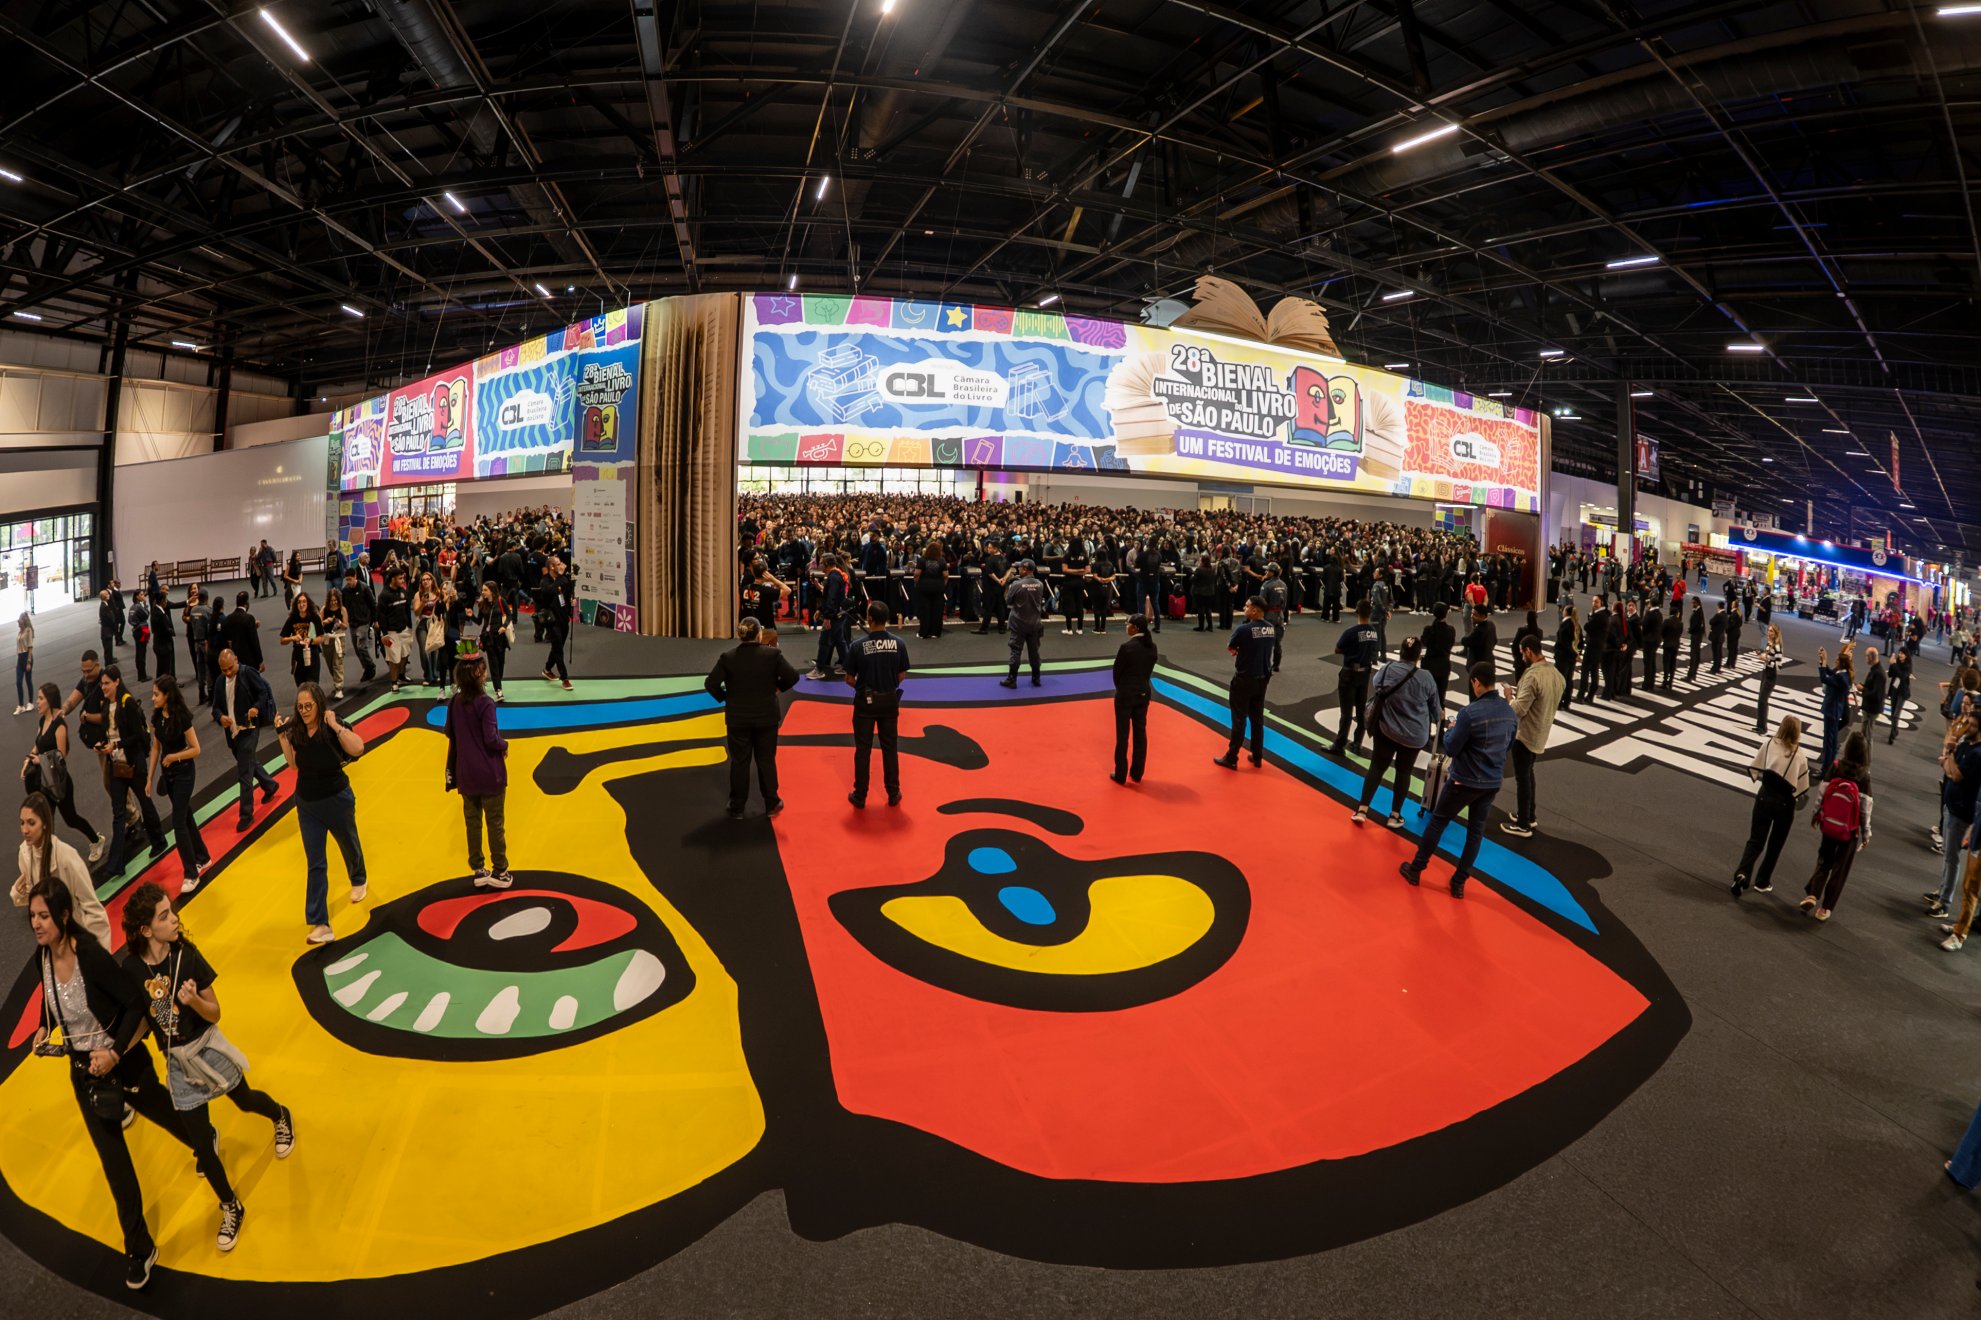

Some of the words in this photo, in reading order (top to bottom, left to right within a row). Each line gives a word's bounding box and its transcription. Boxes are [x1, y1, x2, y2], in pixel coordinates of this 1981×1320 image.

[593, 364, 624, 383] BIENAL
[953, 375, 990, 384] Câmara
[1202, 362, 1278, 392] BIENAL
[607, 376, 631, 392] LIVRO
[886, 372, 945, 398] CBL
[953, 385, 998, 393] Brasileira
[599, 391, 621, 403] PAULO
[967, 393, 993, 401] Livro
[1155, 380, 1238, 403] INTERNACIONAL
[1241, 390, 1296, 418] LIVRO
[1169, 403, 1182, 415] DE
[1181, 400, 1218, 427] SÃO
[1221, 409, 1274, 437] PAULO
[1180, 435, 1203, 455] UM
[1208, 439, 1271, 463] FESTIVAL
[1275, 448, 1291, 466] DE
[1295, 452, 1351, 474] EMOÇÕES
[423, 457, 430, 470] DE
[876, 639, 898, 650] CAVA
